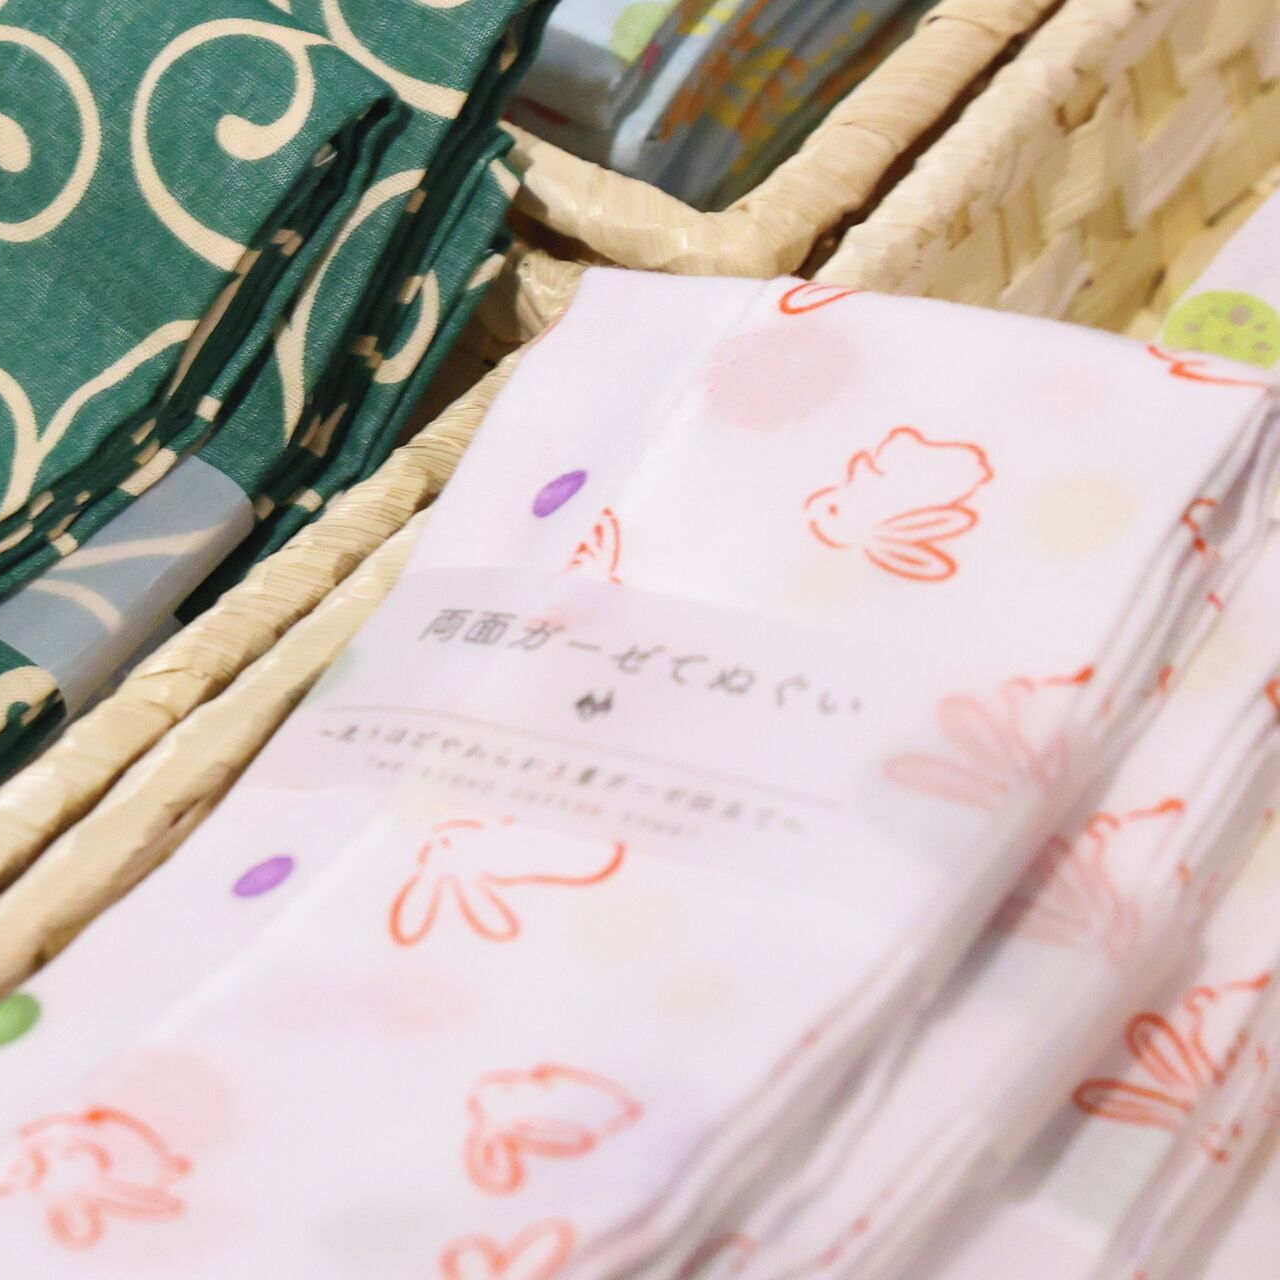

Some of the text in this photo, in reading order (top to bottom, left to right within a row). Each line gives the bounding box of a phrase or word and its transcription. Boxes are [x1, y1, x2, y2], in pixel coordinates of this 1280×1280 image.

[417, 608, 863, 715] 両面ガーゼてぬぐい
